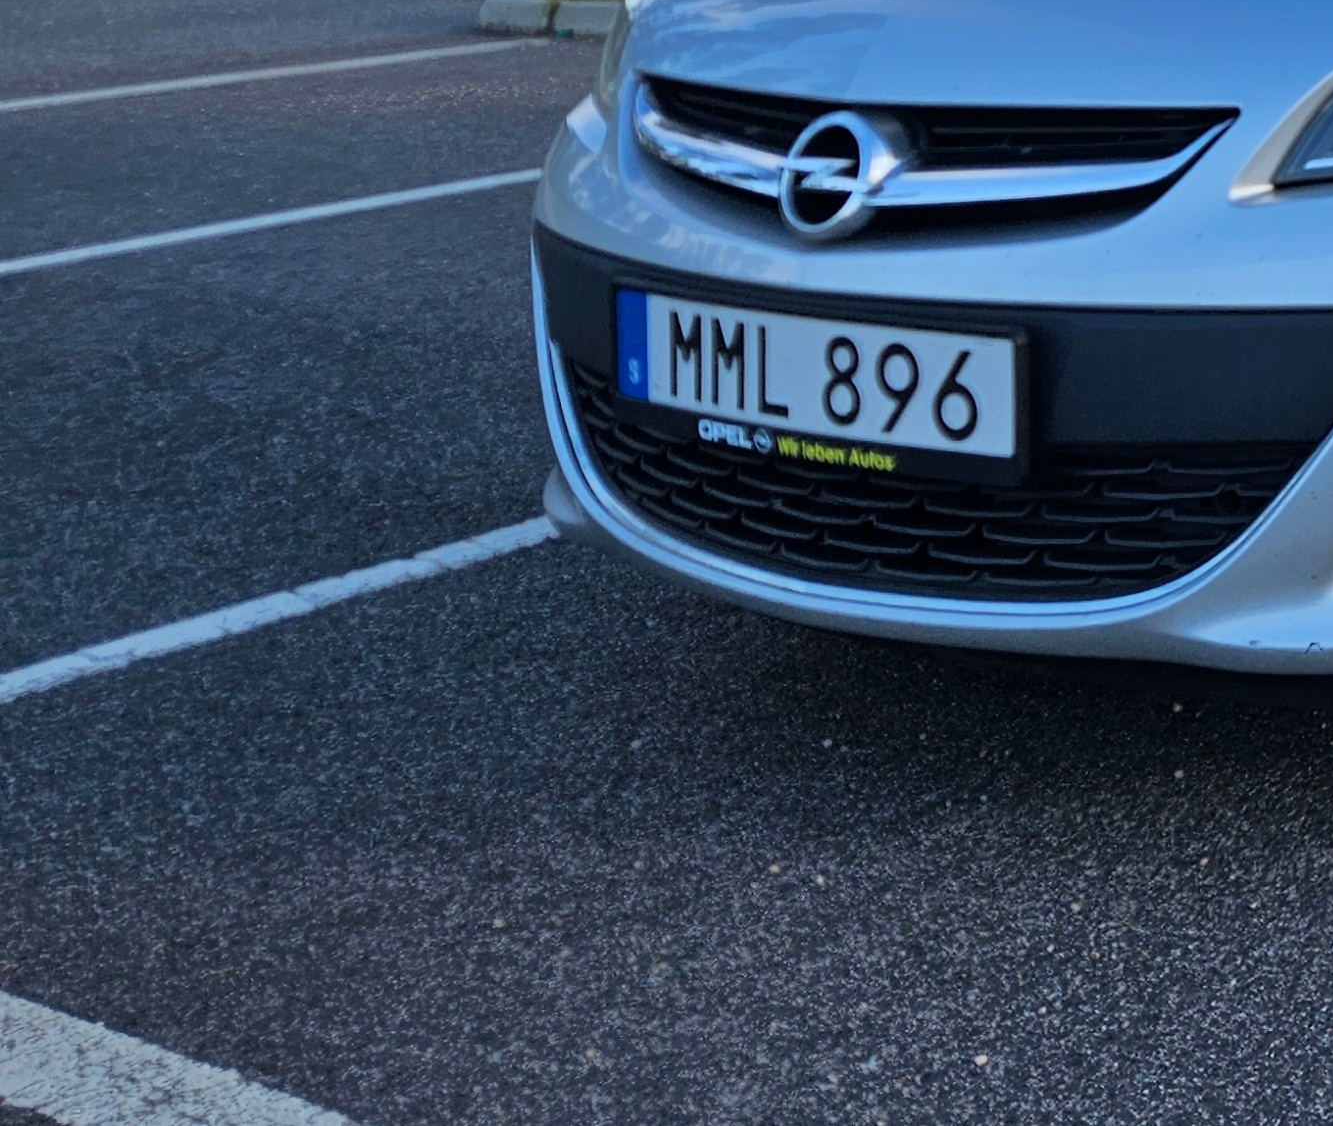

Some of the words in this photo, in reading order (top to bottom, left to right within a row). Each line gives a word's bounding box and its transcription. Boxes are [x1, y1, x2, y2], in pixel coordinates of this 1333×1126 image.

[628, 358, 640, 384] S
[669, 310, 789, 419] MML
[822, 336, 979, 441] 896
[698, 419, 752, 450] OPEL
[777, 436, 799, 458] Wir
[802, 440, 845, 465] leben
[849, 448, 896, 472] Autos
